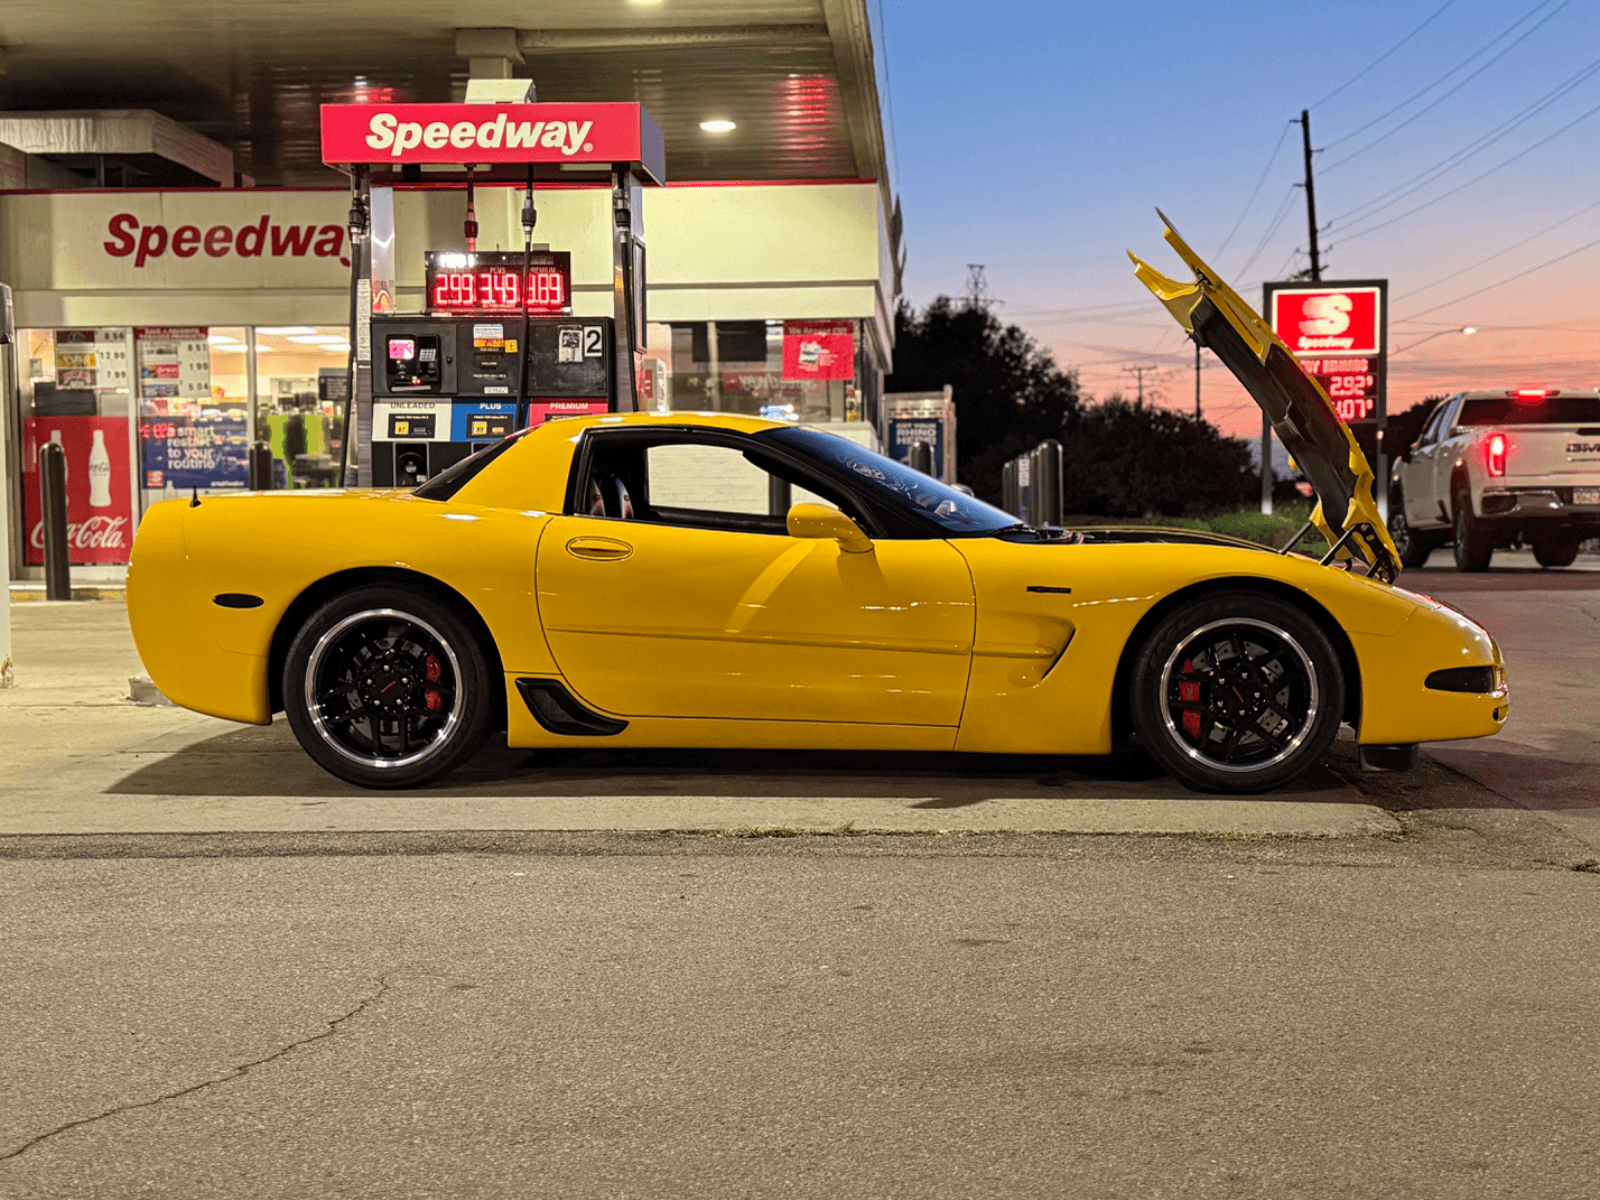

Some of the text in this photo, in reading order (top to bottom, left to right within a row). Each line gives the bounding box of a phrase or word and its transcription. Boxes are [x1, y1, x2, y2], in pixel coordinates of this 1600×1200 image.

[365, 113, 593, 156] Speedway
[103, 213, 352, 268] Speedwa
[586, 329, 602, 353] 2
[479, 402, 502, 410] PLUS
[549, 402, 588, 410] PREMIUM
[167, 448, 214, 460] to your
[167, 459, 216, 469] routine
